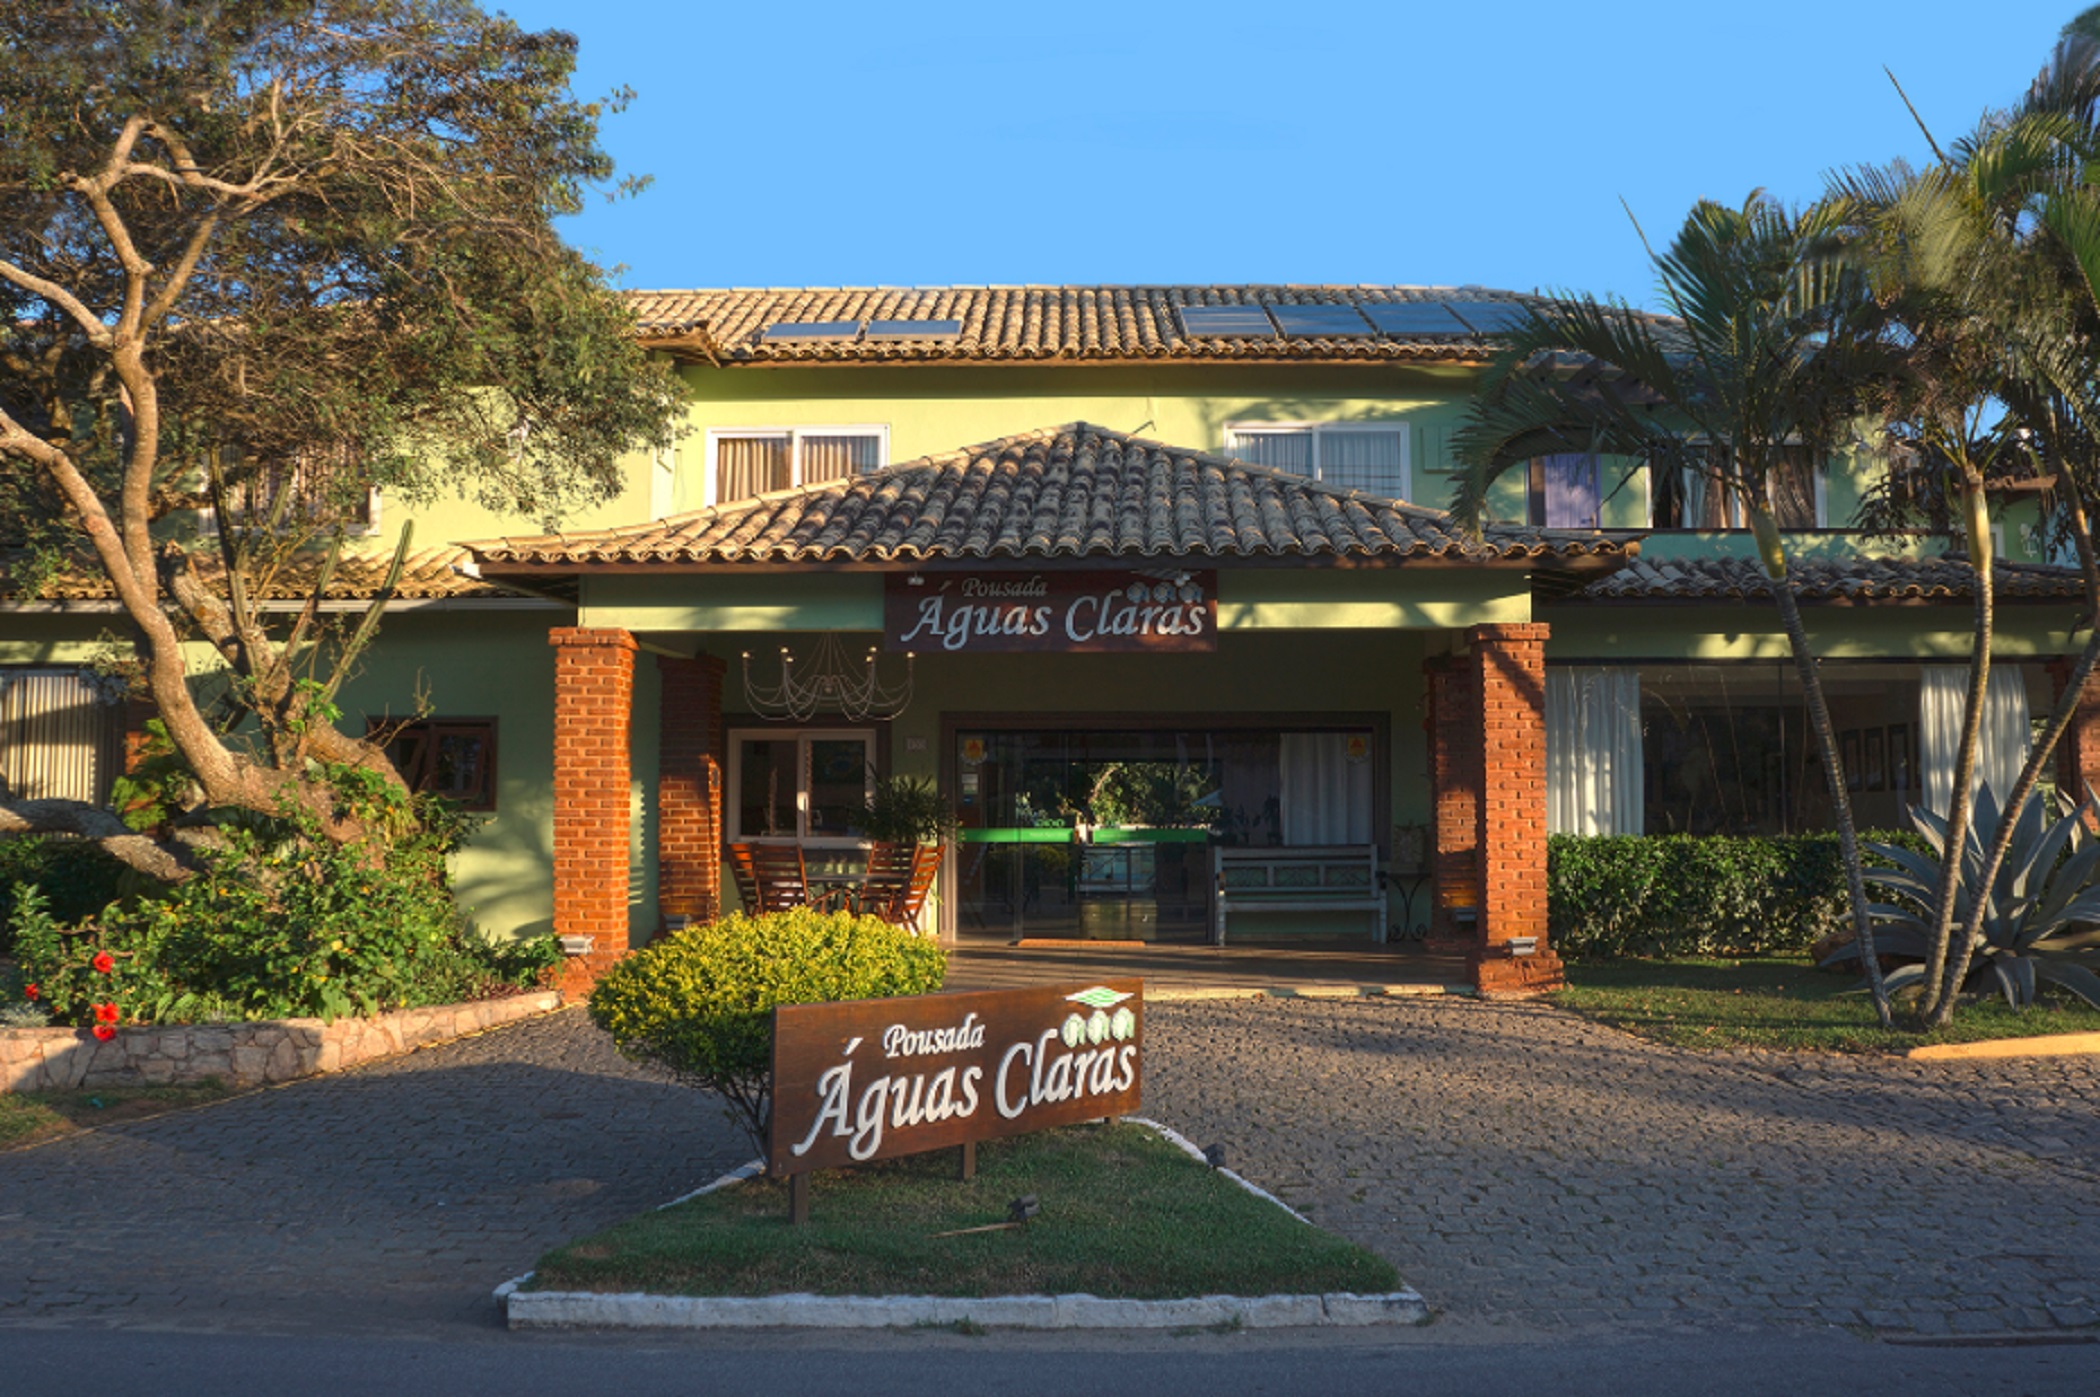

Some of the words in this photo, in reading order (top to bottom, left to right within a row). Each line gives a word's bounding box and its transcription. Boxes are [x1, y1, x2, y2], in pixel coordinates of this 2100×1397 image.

[900, 580, 1052, 651] Águas
[1064, 589, 1207, 642] Claras
[961, 575, 1048, 598] Pousada
[882, 1012, 986, 1059] Pousada
[791, 1037, 983, 1161] Águas
[995, 1028, 1137, 1119] Claras
